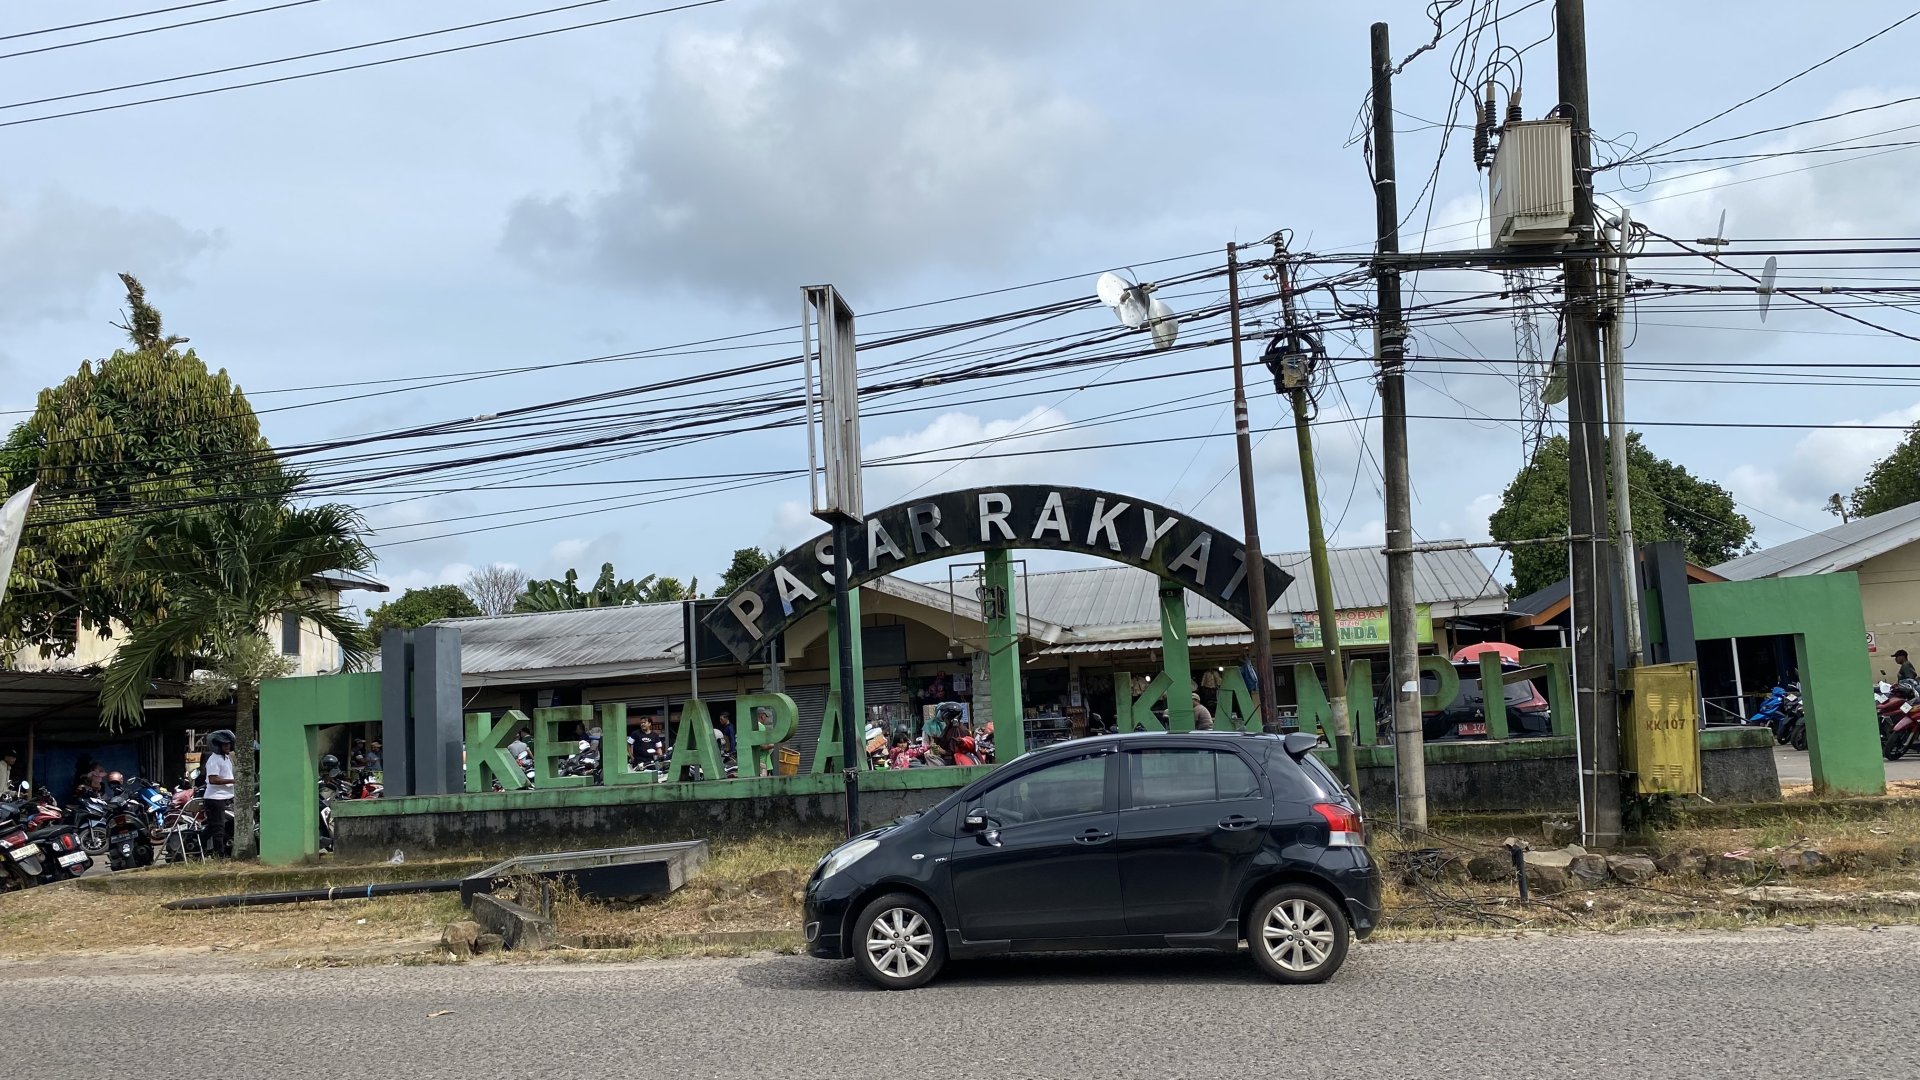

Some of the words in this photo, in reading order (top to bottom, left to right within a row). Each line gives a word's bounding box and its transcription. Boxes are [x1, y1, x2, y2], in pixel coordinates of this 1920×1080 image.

[728, 503, 950, 641] PASAR
[978, 491, 1250, 601] RAKYAT
[1303, 612, 1341, 622] TOO
[1347, 609, 1385, 620] OBAT
[1314, 626, 1377, 640] BNDA
[1663, 718, 1686, 730] 107
[465, 692, 869, 793] KELAPA
